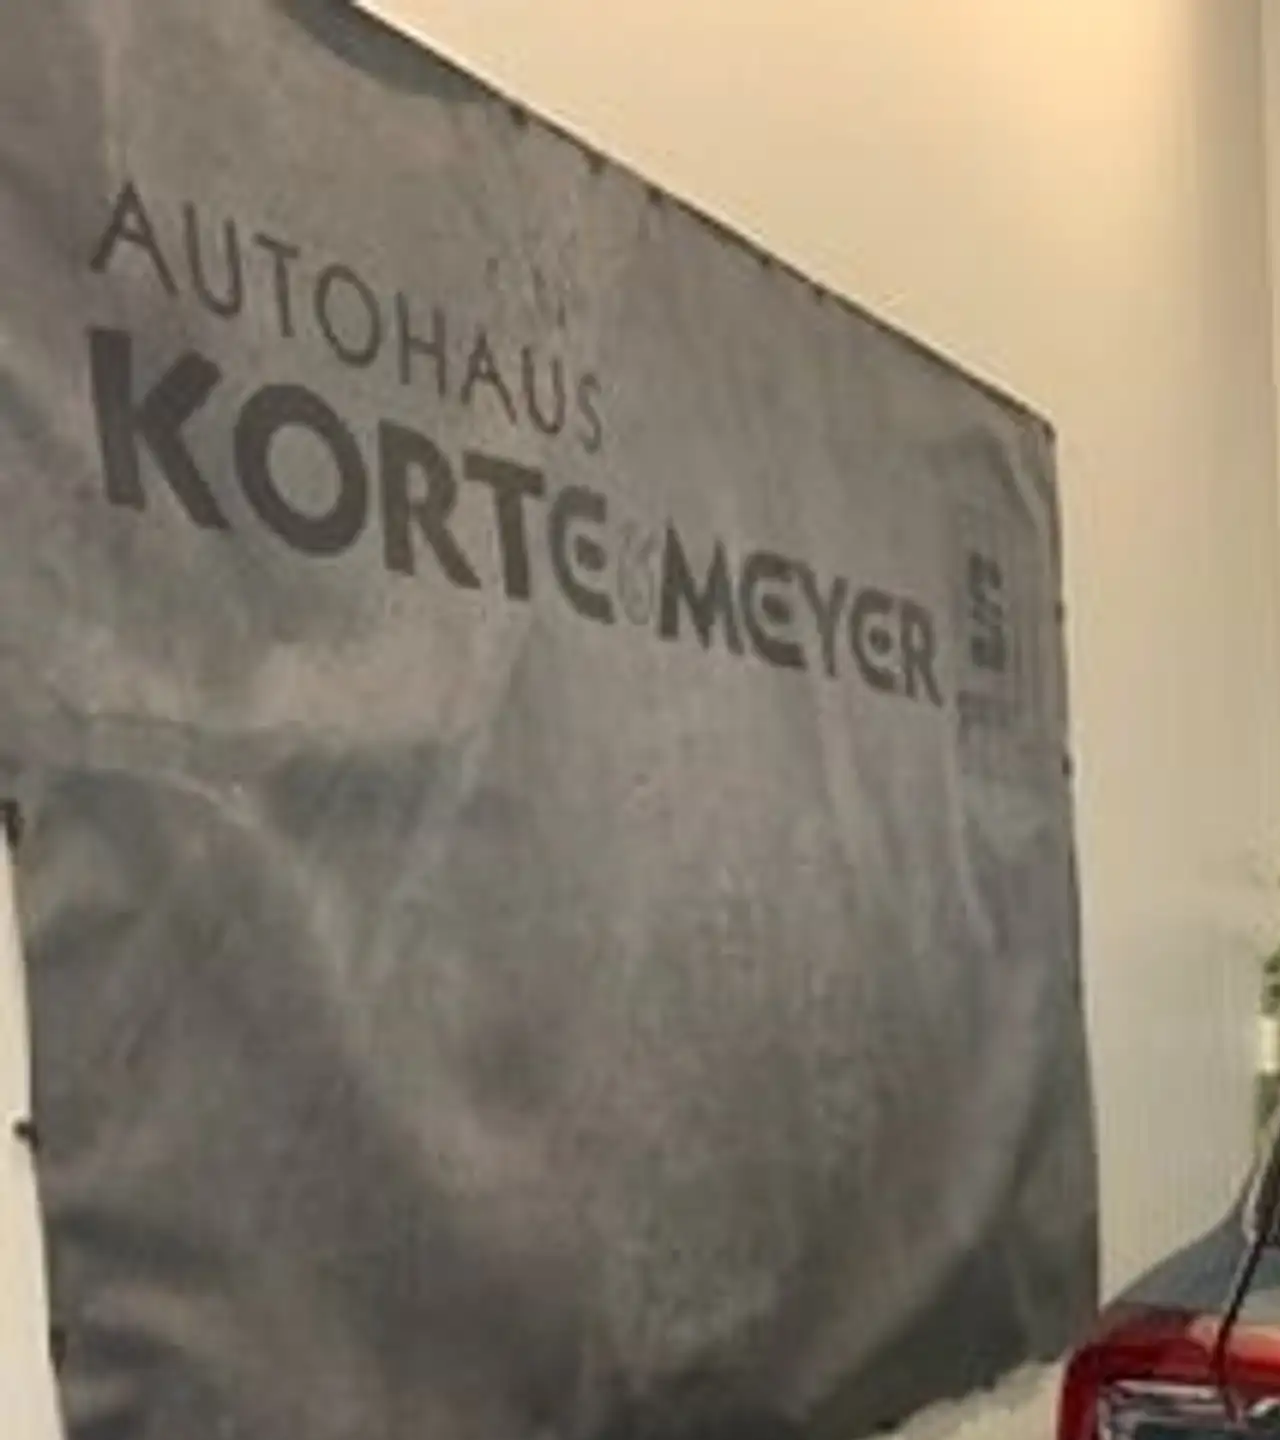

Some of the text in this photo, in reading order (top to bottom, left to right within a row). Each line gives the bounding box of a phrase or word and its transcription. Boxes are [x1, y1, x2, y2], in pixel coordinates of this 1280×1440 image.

[89, 180, 606, 454] AUTOHAUS
[88, 328, 615, 626] KORTE
[657, 516, 944, 708] MEYER
